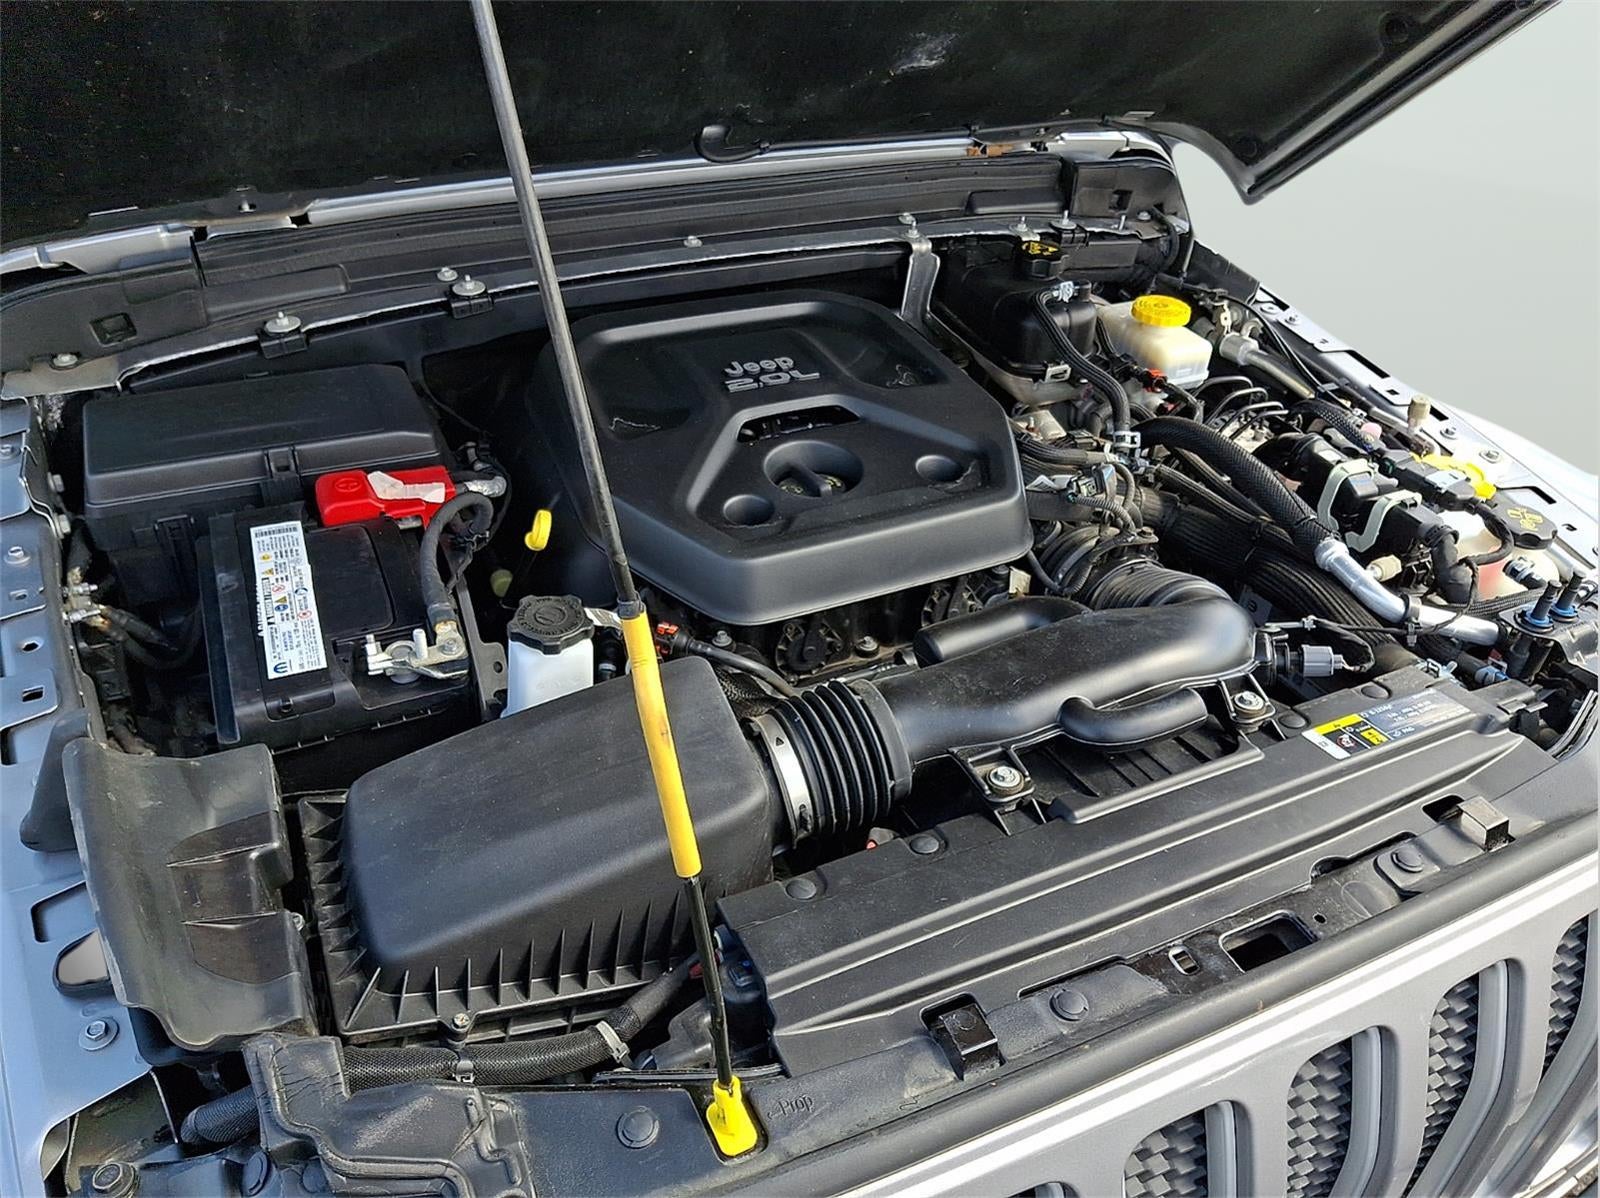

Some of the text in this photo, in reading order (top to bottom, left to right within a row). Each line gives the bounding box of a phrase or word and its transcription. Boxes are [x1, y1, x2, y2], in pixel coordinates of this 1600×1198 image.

[724, 356, 794, 377] Jeep
[724, 370, 820, 393] 2.0L
[778, 1095, 814, 1116] Prop
